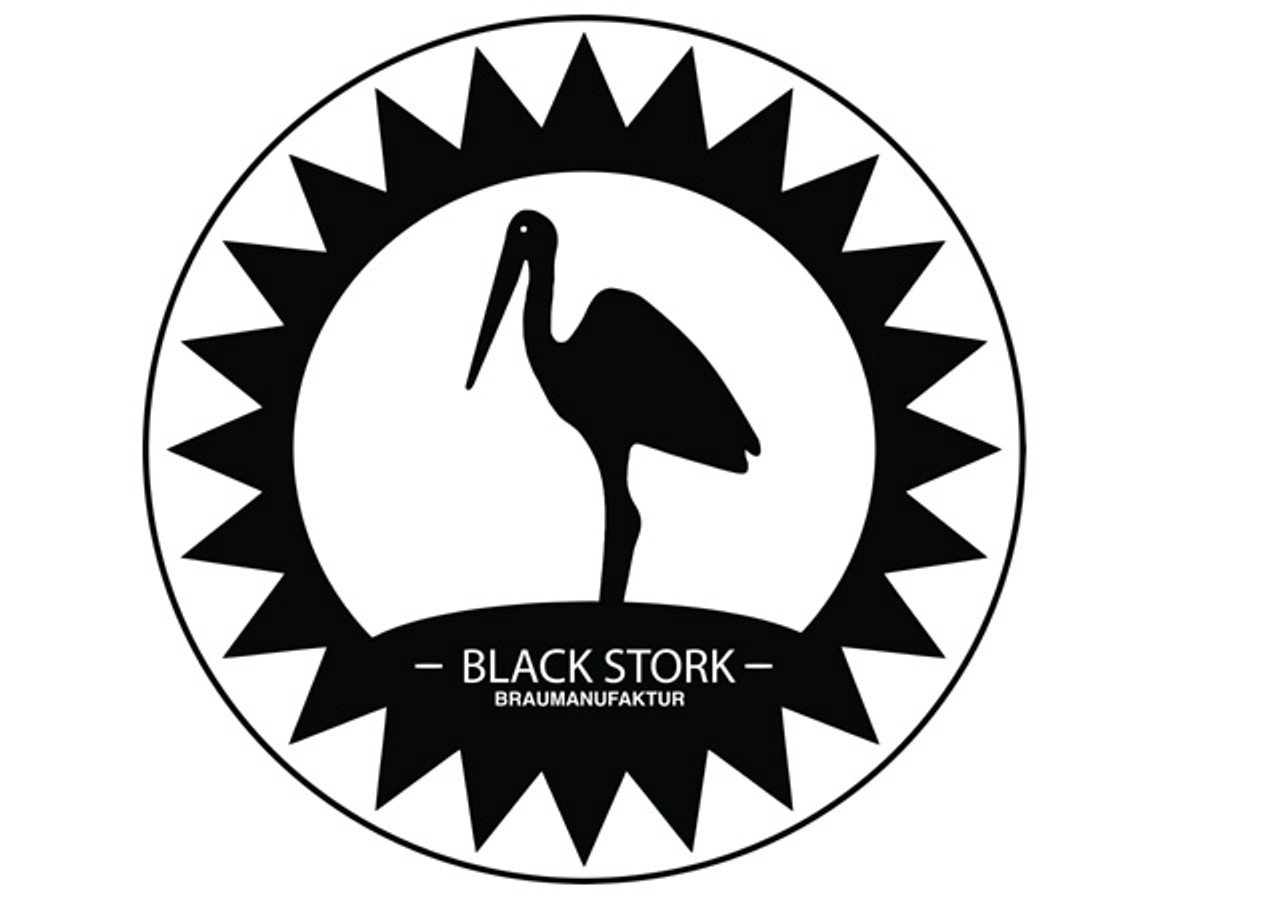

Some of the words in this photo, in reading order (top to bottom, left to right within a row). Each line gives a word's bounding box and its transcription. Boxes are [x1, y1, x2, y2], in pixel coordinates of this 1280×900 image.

[463, 649, 594, 684] BLACK
[604, 648, 737, 684] STORK
[494, 690, 686, 708] BRAUMANUFAKTUR
